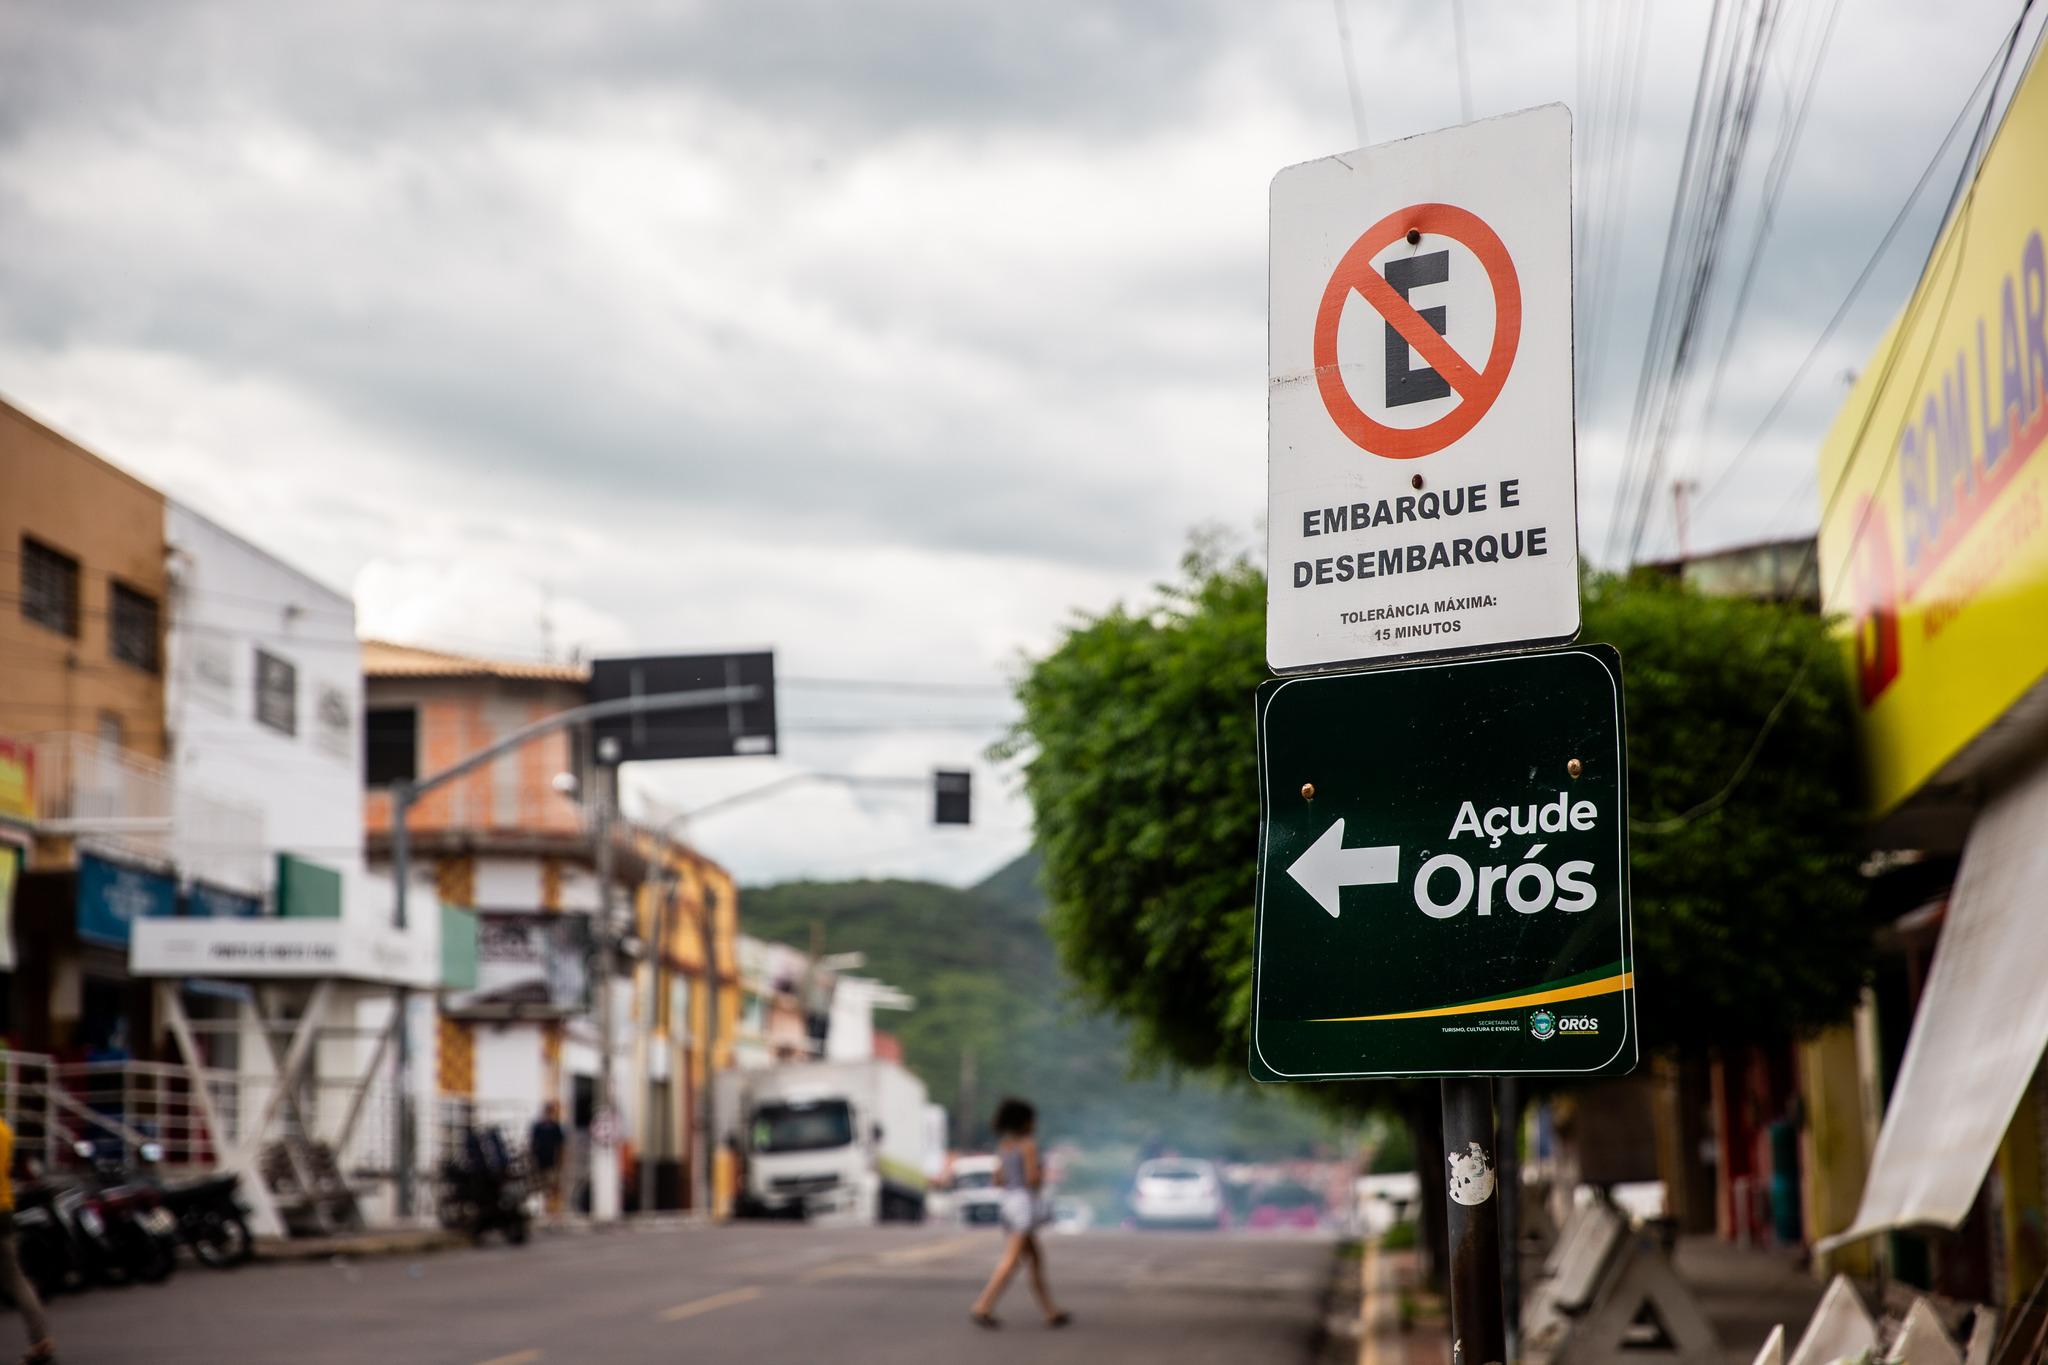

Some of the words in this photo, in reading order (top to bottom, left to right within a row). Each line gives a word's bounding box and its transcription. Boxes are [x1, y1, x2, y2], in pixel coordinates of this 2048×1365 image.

[1384, 249, 1451, 409] E
[1303, 483, 1488, 538] EMBARQUE
[1499, 478, 1520, 509] E
[1293, 526, 1548, 589] DESEMBARQUE
[1340, 603, 1430, 625] TOLERÂNCIA
[1434, 595, 1498, 613] MÁXIMA:
[1374, 629, 1391, 641] 15
[1395, 619, 1462, 639] MINUTOS
[1448, 791, 1598, 849] Açude
[1413, 843, 1598, 920] Orós
[1558, 1014, 1599, 1031] ORÓS
